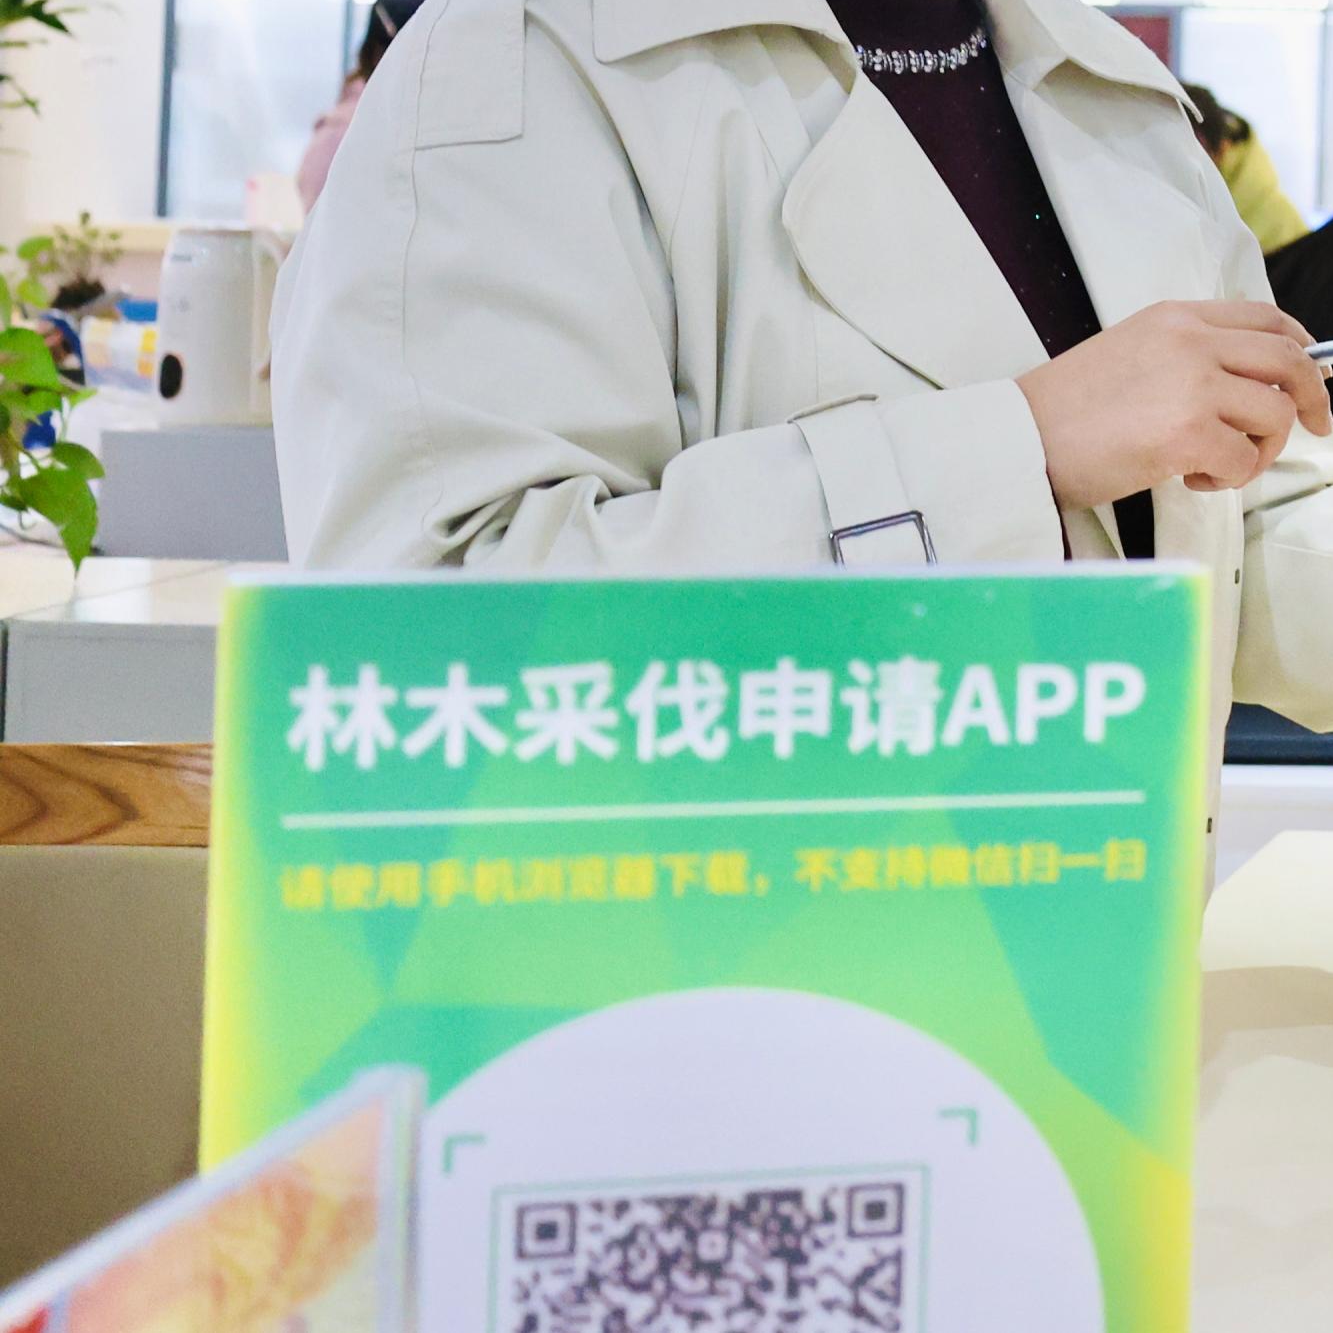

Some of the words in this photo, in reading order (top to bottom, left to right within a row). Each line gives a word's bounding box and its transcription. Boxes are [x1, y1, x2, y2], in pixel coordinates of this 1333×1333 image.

[285, 655, 1147, 771] 林木采伐申请APP
